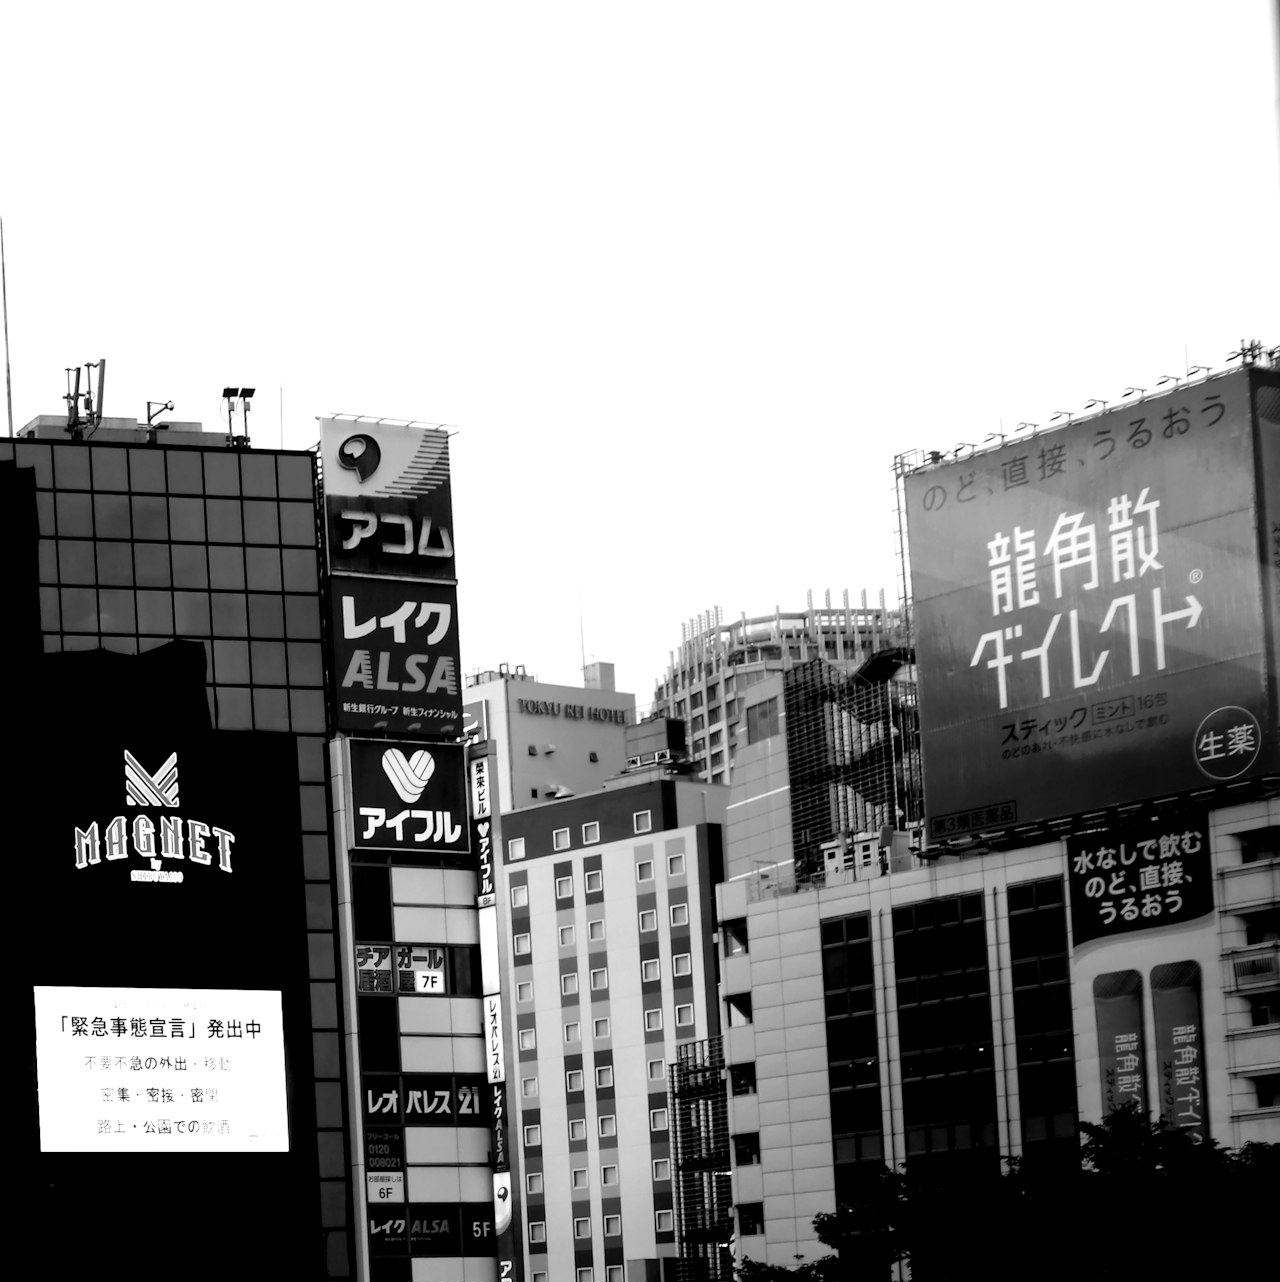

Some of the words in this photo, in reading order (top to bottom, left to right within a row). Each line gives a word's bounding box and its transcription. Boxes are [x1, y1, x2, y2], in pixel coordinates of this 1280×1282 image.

[923, 394, 1227, 512] のど、直接、うるおう
[340, 509, 454, 558] アコム
[987, 487, 1164, 617] 龍角散
[342, 595, 452, 646] レイク
[970, 586, 1204, 710] ダイレクト
[342, 649, 458, 696] ALSA
[343, 702, 399, 715] 新生銀行グループ
[402, 706, 458, 720] 新生フィナンシャル
[518, 698, 561, 716] TOKYU
[565, 703, 584, 719] REI
[589, 705, 627, 724] HOTEL
[1001, 706, 1088, 746] スティック
[1198, 723, 1256, 762] 生薬
[75, 814, 236, 874] MAGNET
[358, 807, 463, 845] アイフル
[478, 838, 493, 895] アイフル
[1072, 829, 1203, 876] 水なしで飲む
[1098, 889, 1184, 925] うるおう
[422, 975, 439, 989] 7F
[368, 1144, 390, 1155] 0120
[379, 1187, 393, 1199] 6F
[370, 1219, 406, 1235] レイク
[410, 1218, 450, 1234] ALSA
[472, 1221, 491, 1238] 5F
